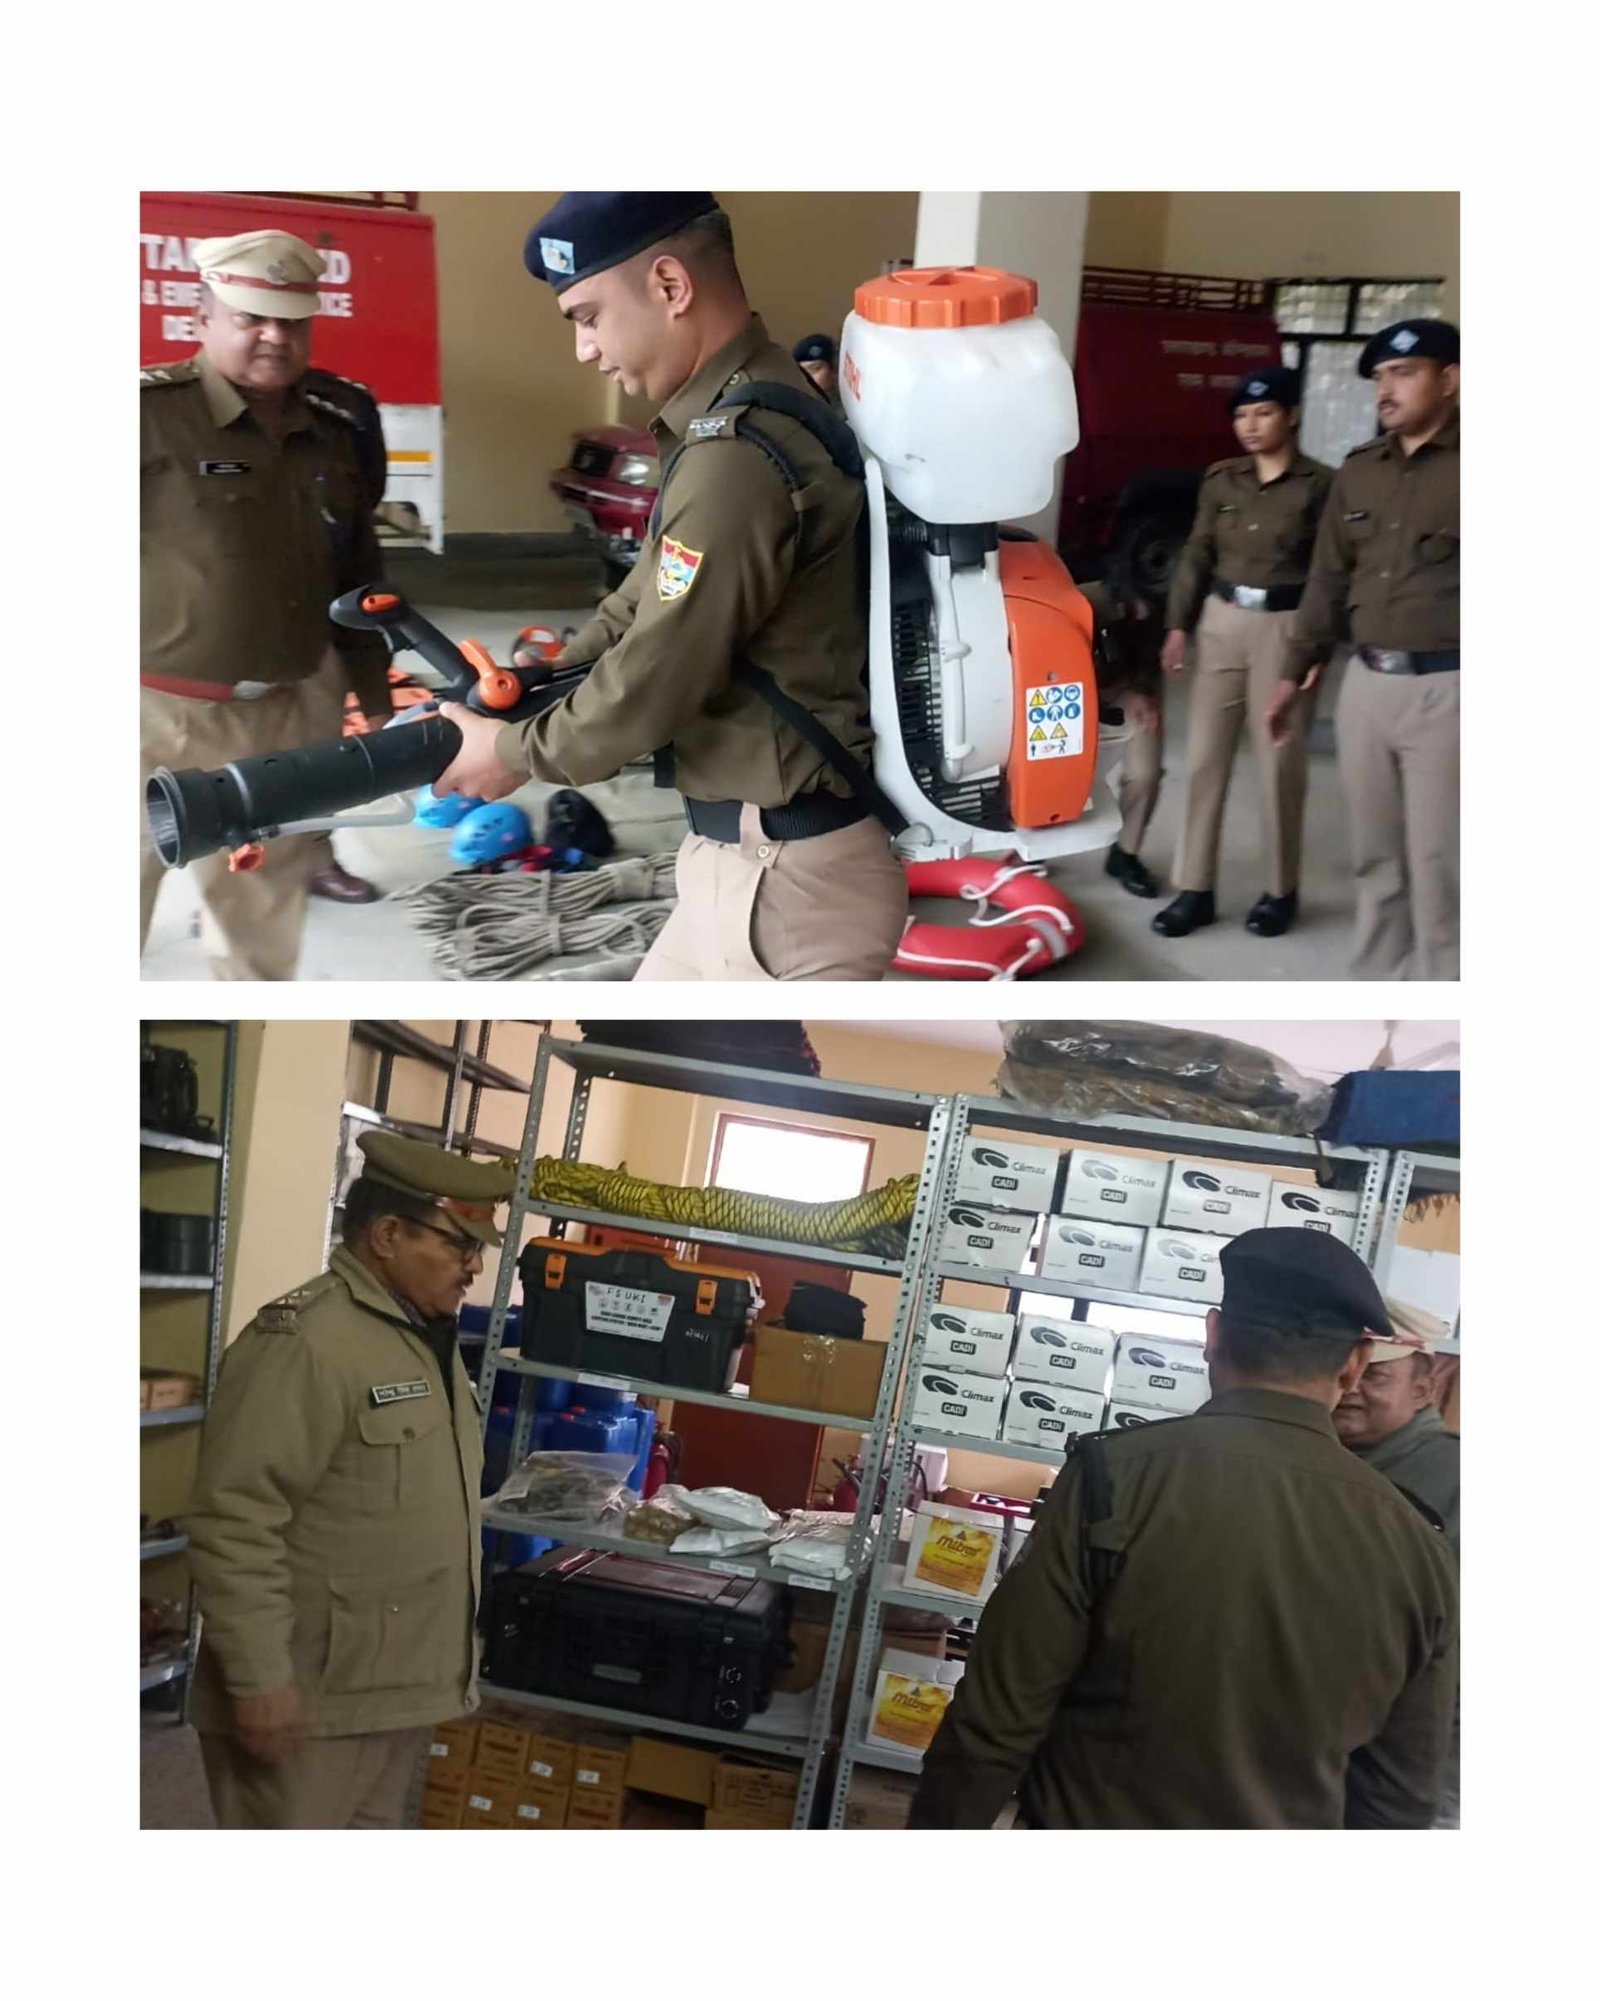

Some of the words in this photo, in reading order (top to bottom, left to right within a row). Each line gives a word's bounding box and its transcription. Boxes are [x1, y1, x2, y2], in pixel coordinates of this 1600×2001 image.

[1012, 1161, 1046, 1175] Climax
[1122, 1175, 1156, 1188] Climax
[1224, 1186, 1261, 1198] Climax
[988, 1221, 1021, 1233] Climax
[1100, 1240, 1133, 1252] Climax
[971, 1328, 1004, 1340] Climax
[1071, 1342, 1104, 1355] Climax
[1170, 1362, 1205, 1374] Climax
[962, 1390, 994, 1403] Climax
[1060, 1406, 1093, 1419] Climax
